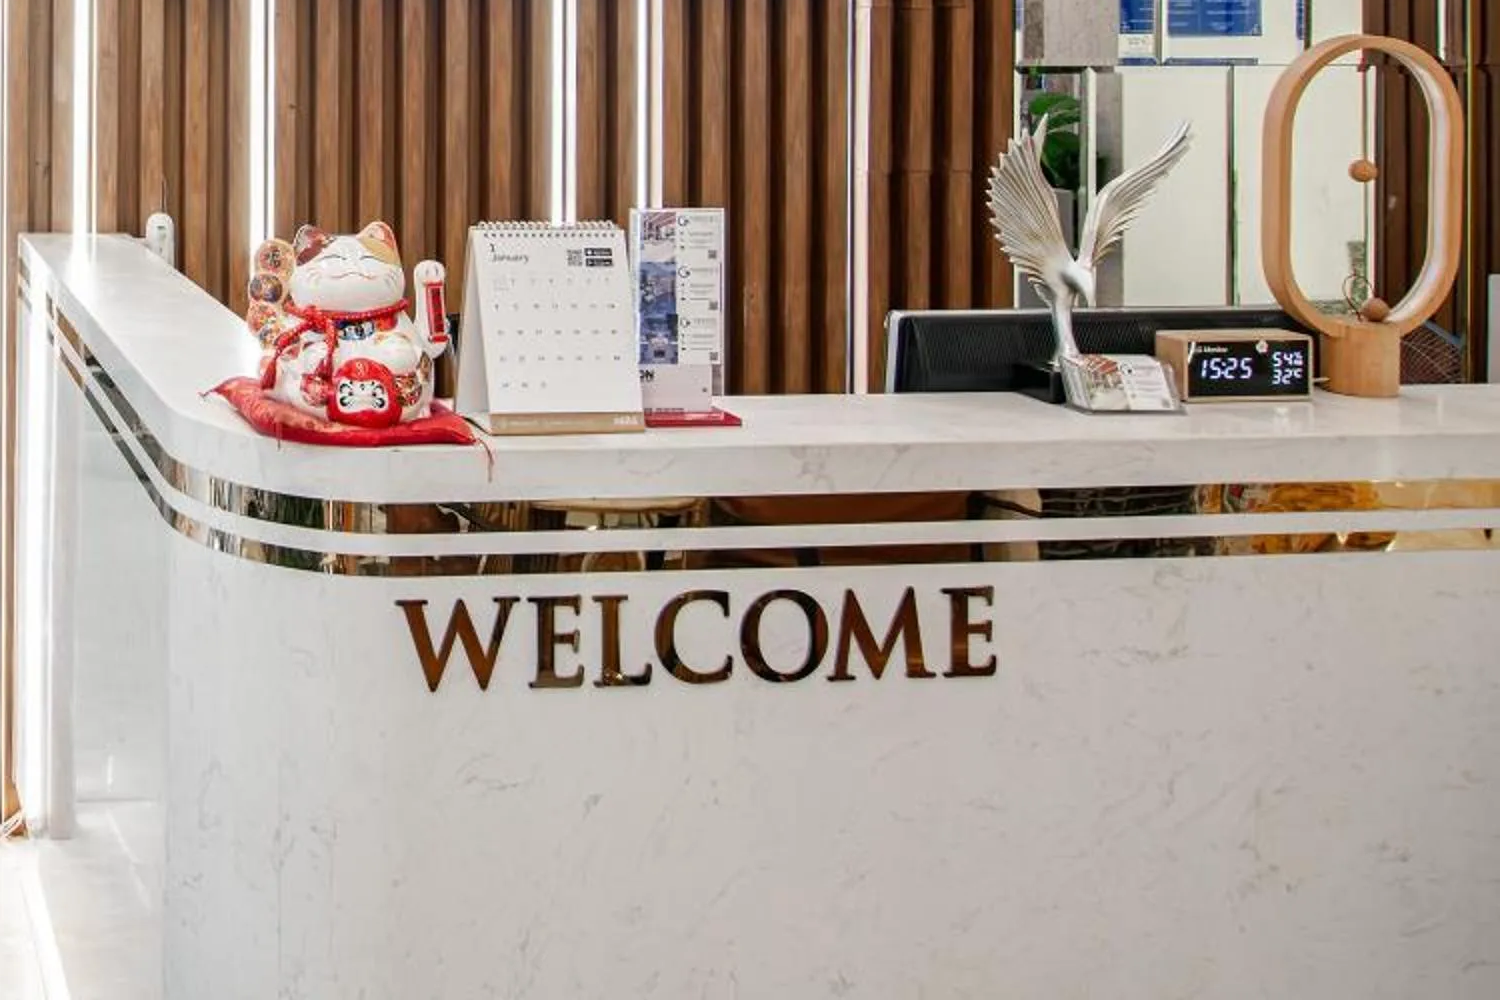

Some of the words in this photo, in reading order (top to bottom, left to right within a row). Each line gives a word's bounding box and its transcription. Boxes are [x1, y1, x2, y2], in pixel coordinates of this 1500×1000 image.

[491, 253, 530, 264] January
[1200, 356, 1254, 379] 15:25
[393, 584, 998, 693] WELCOME
